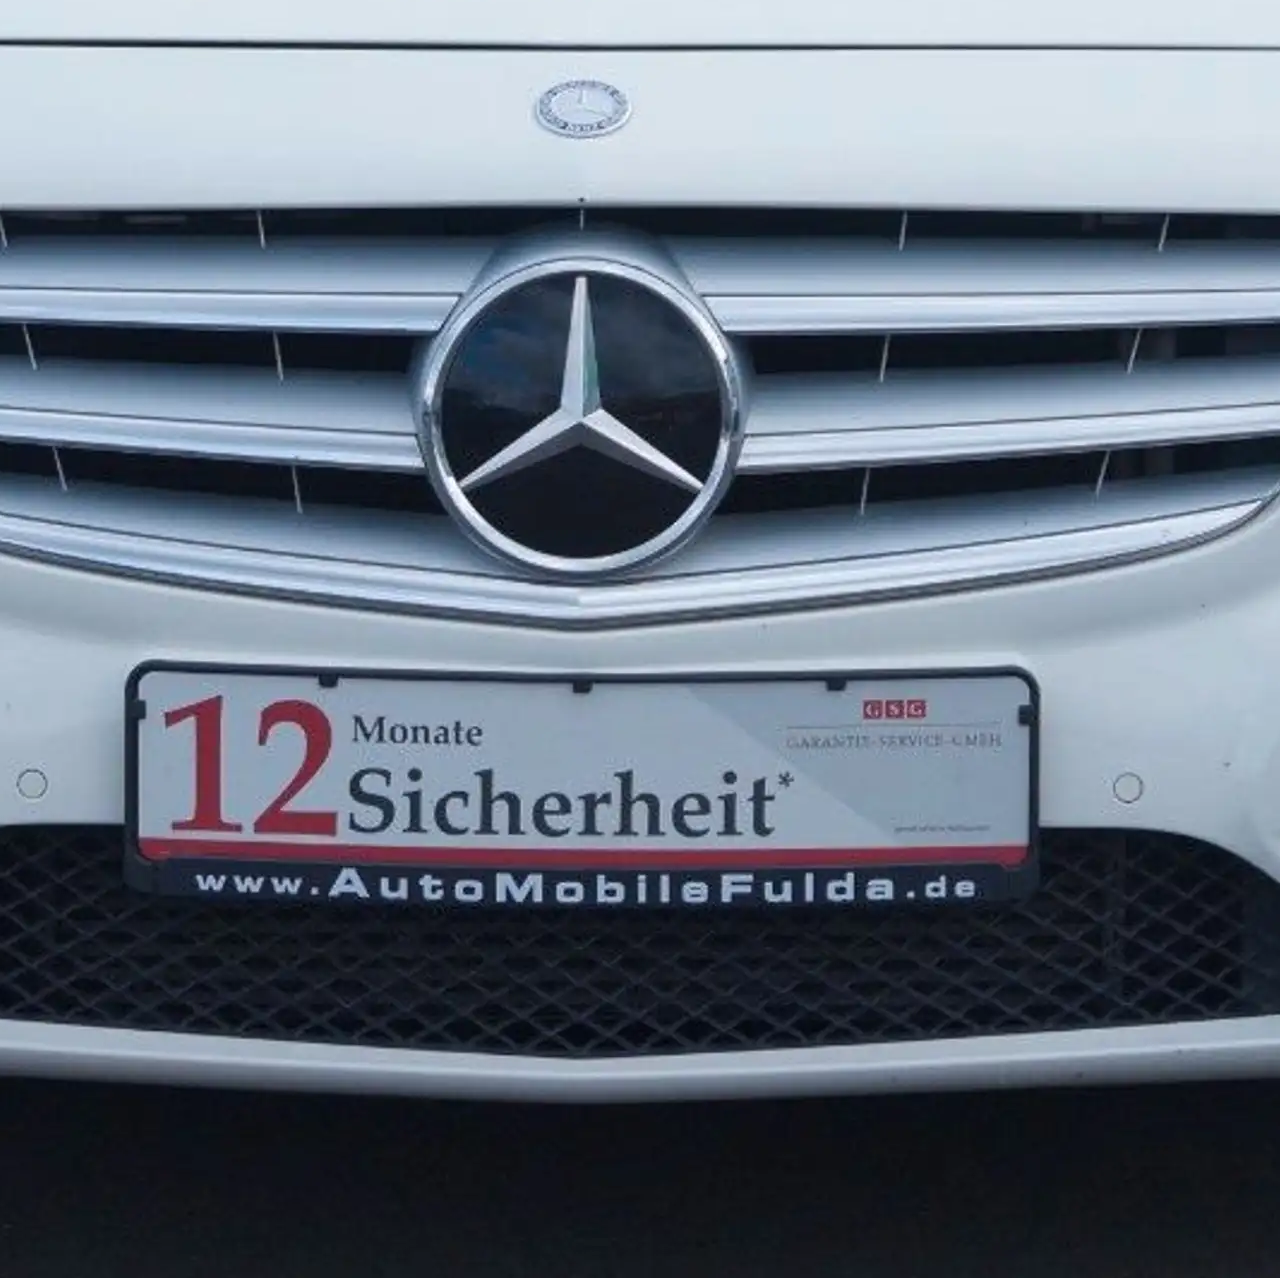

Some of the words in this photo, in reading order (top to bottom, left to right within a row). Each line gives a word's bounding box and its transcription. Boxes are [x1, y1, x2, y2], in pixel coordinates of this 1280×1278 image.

[164, 695, 338, 836] 12
[352, 715, 483, 746] Monate
[195, 866, 976, 904] www.AutoMobileFulda.de
